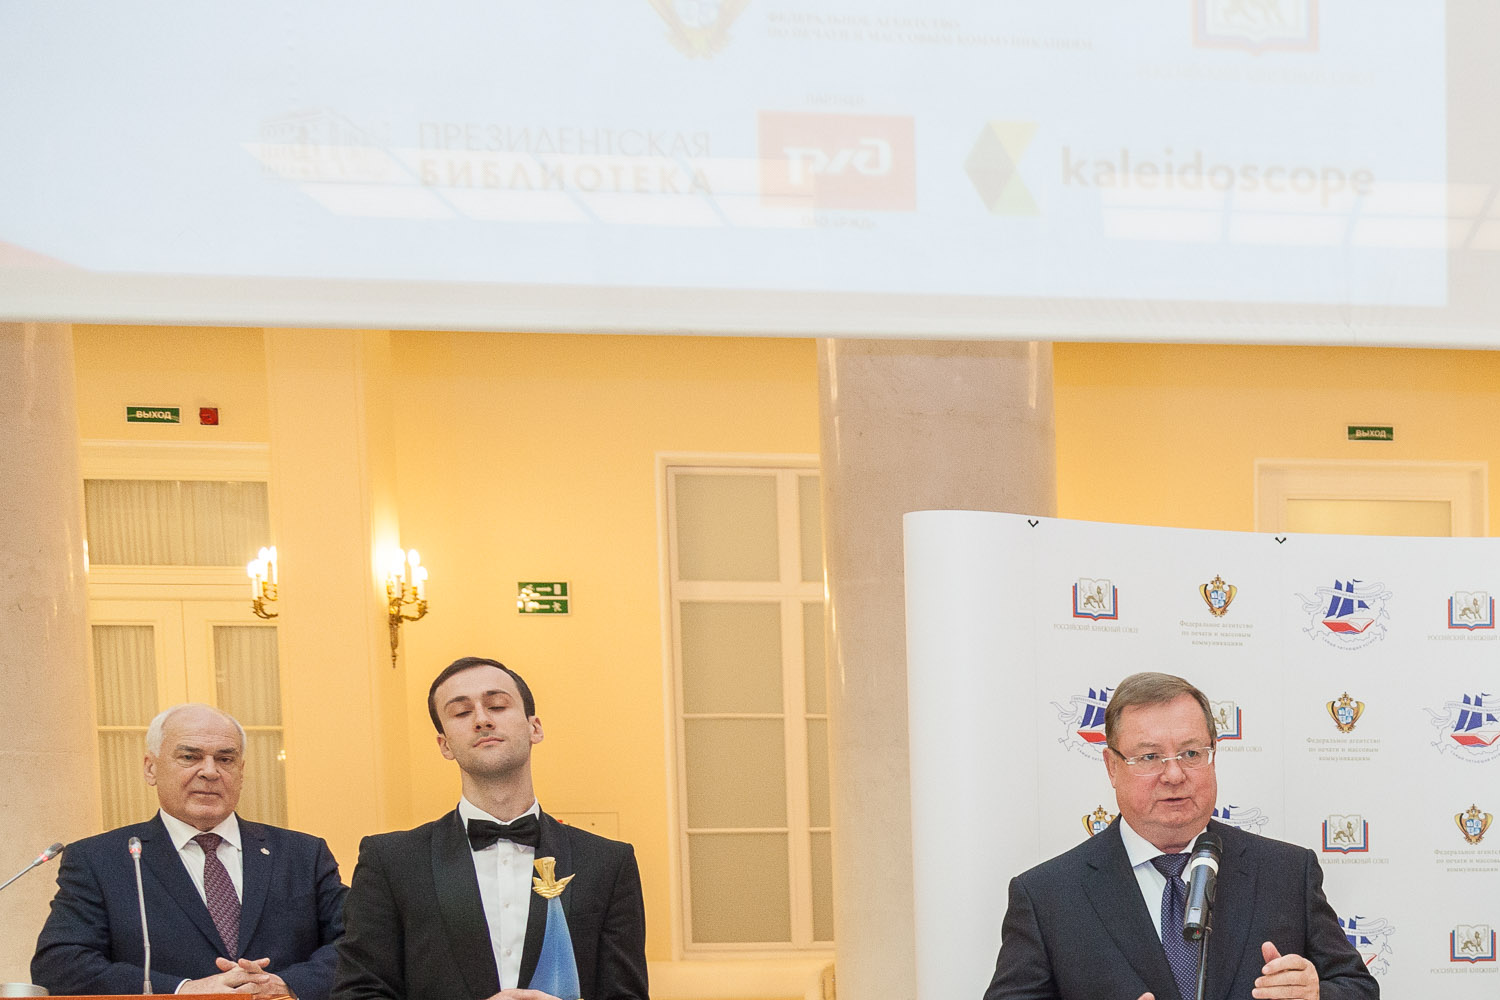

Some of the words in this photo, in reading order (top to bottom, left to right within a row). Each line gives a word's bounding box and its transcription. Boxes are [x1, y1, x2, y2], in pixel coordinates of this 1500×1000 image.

[418, 122, 711, 158] ПРЕЗИДЕНТСКАЯ
[420, 159, 713, 195] БИБЛИОТЕКА
[1060, 145, 1375, 208] kaleidoscope
[136, 410, 172, 420] ВЫХОД
[1355, 429, 1387, 438] ВЫХОД
